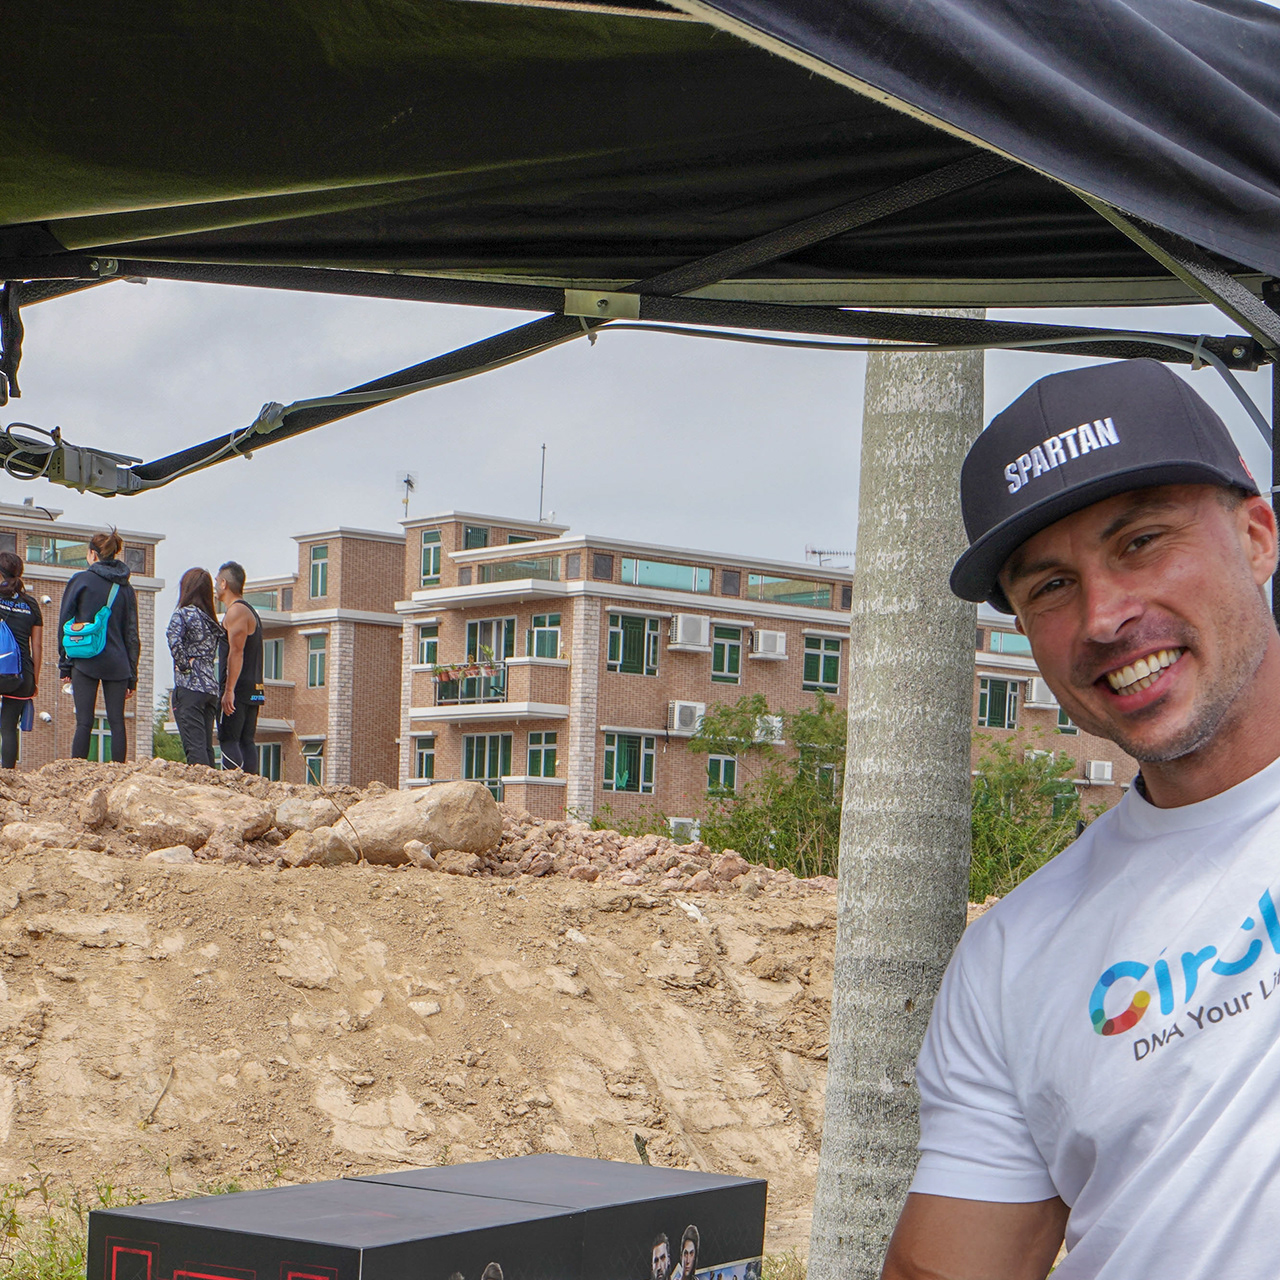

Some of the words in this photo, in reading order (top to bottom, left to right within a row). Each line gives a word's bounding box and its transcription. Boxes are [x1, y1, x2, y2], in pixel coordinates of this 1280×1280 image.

[1003, 417, 1120, 494] SPARTAN
[1133, 1022, 1183, 1061] DNA
[1186, 988, 1253, 1034] Your
